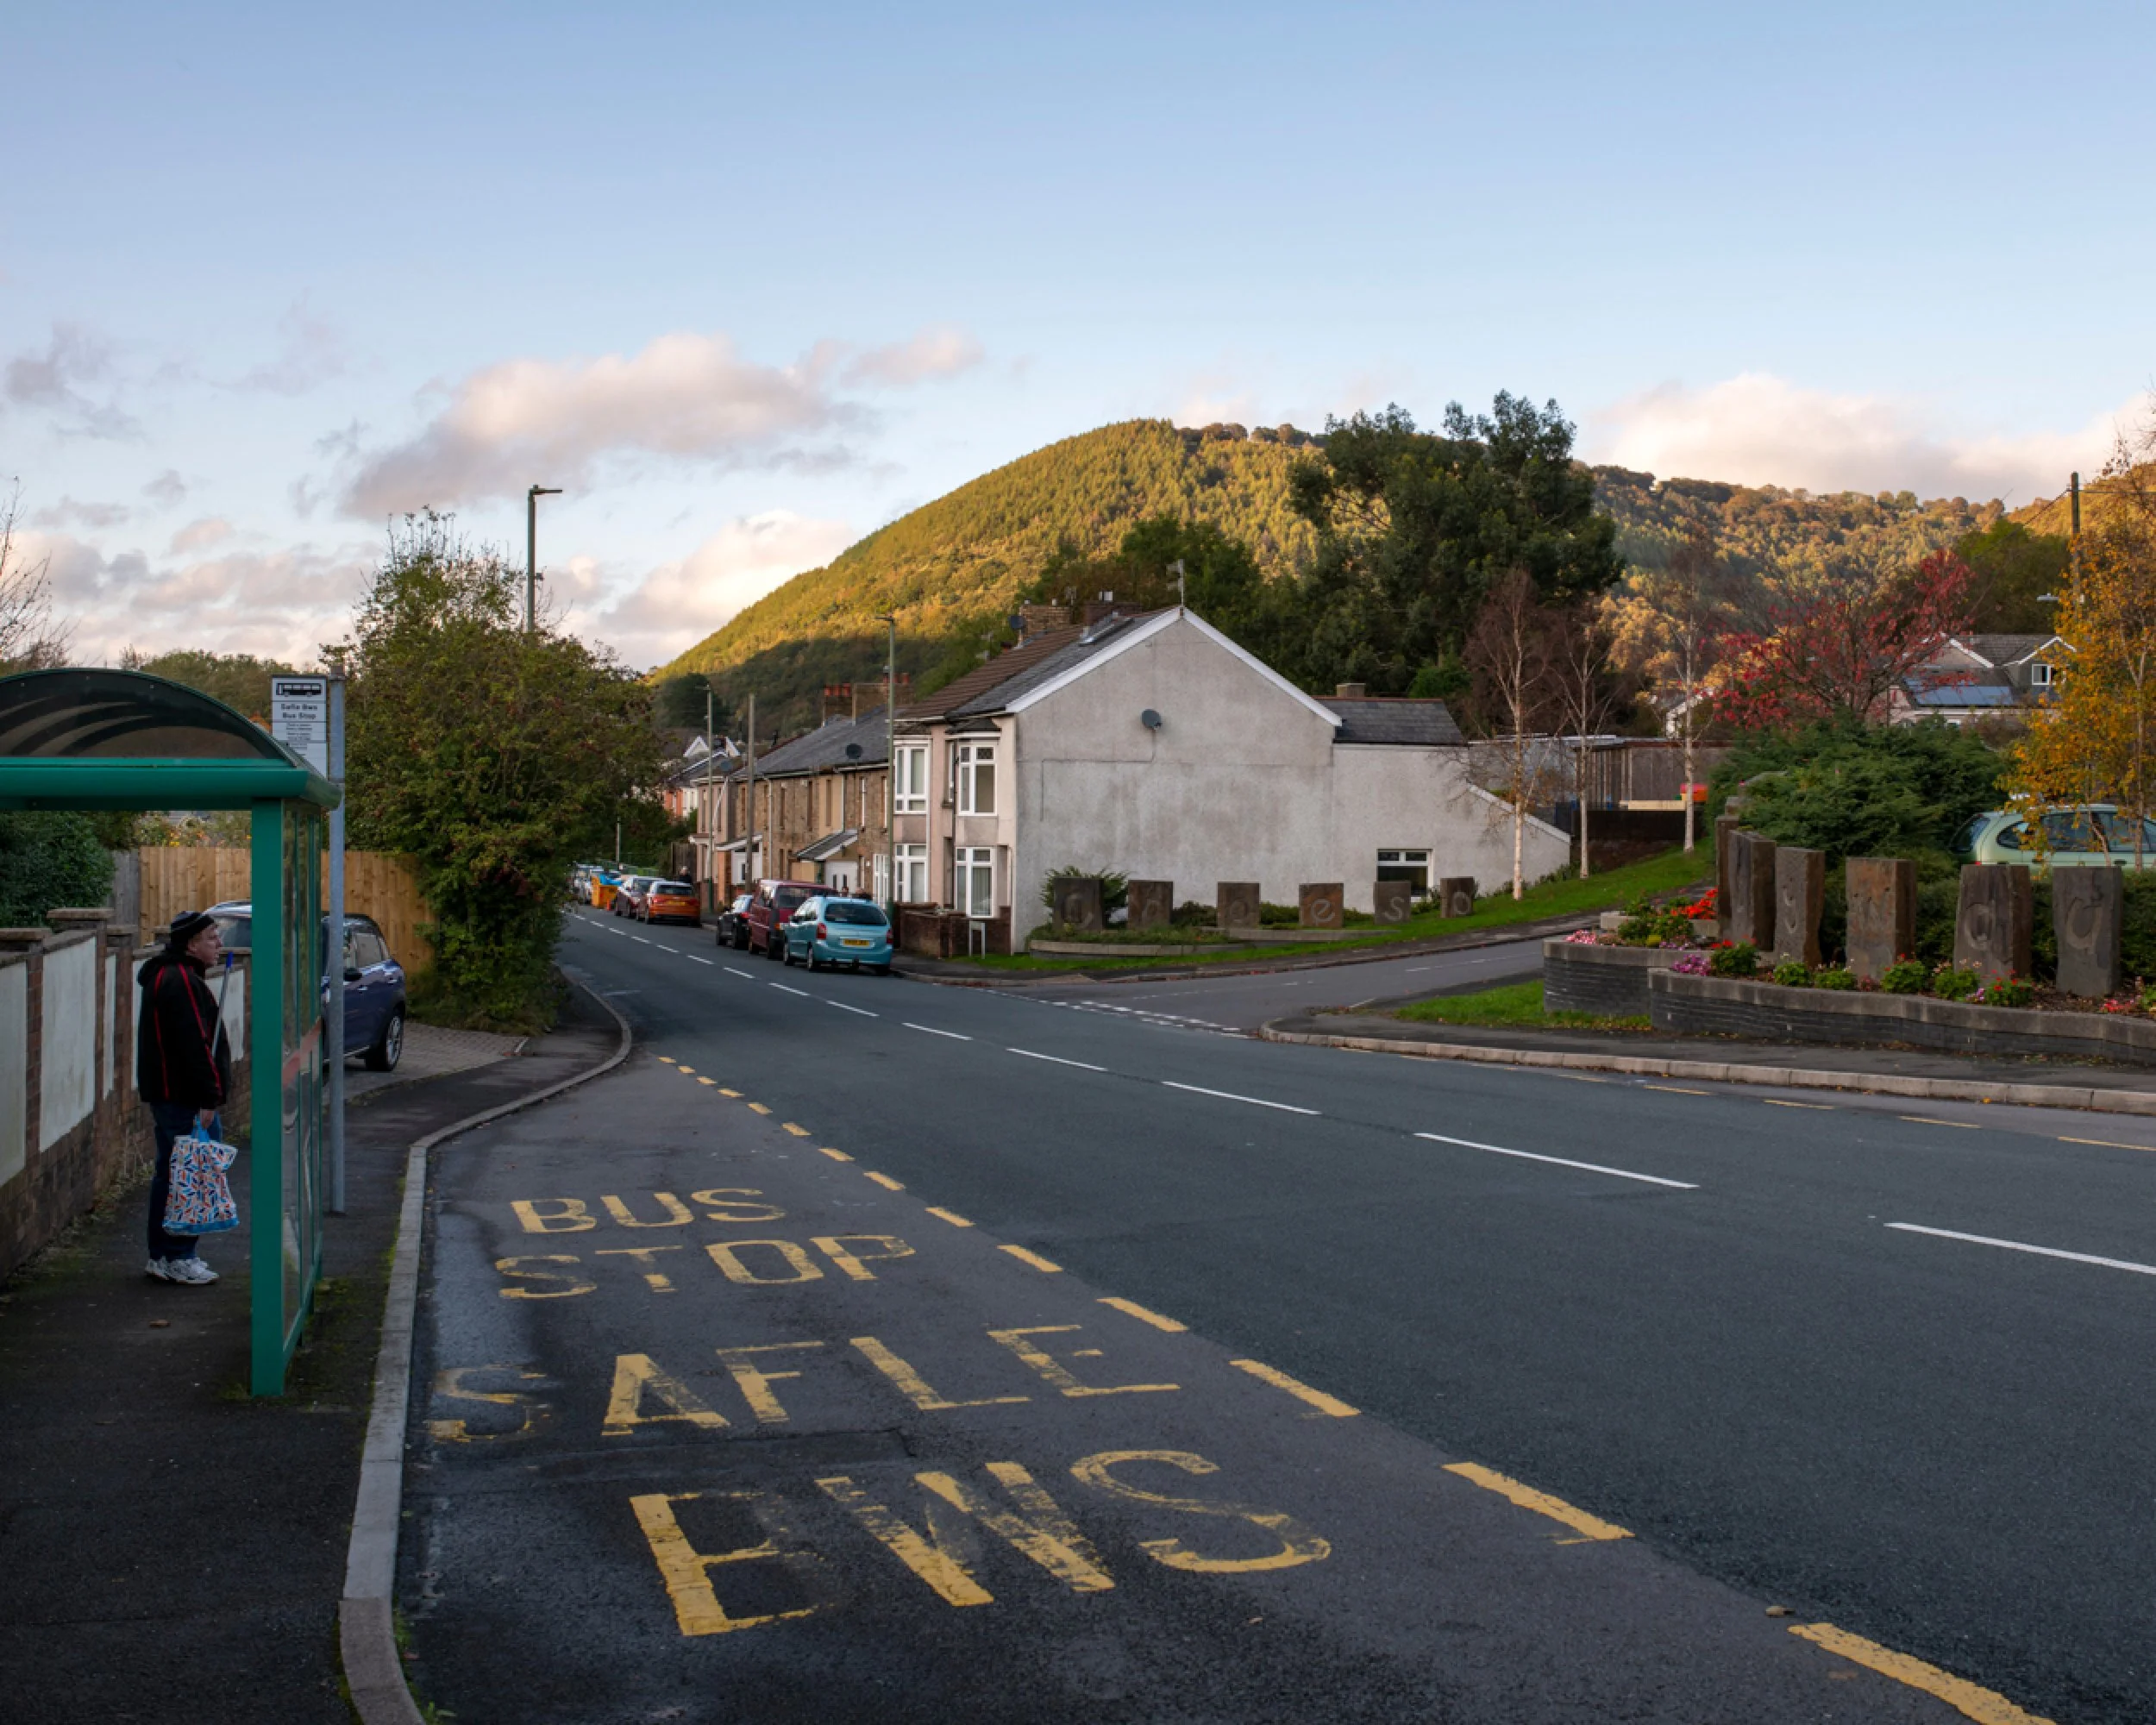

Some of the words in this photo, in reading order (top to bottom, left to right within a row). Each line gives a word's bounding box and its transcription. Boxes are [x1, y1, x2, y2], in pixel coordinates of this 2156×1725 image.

[298, 712, 317, 720] Stop
[511, 1189, 787, 1233] BUS
[495, 1234, 916, 1298] STOP
[425, 1325, 1181, 1445] SAFLE
